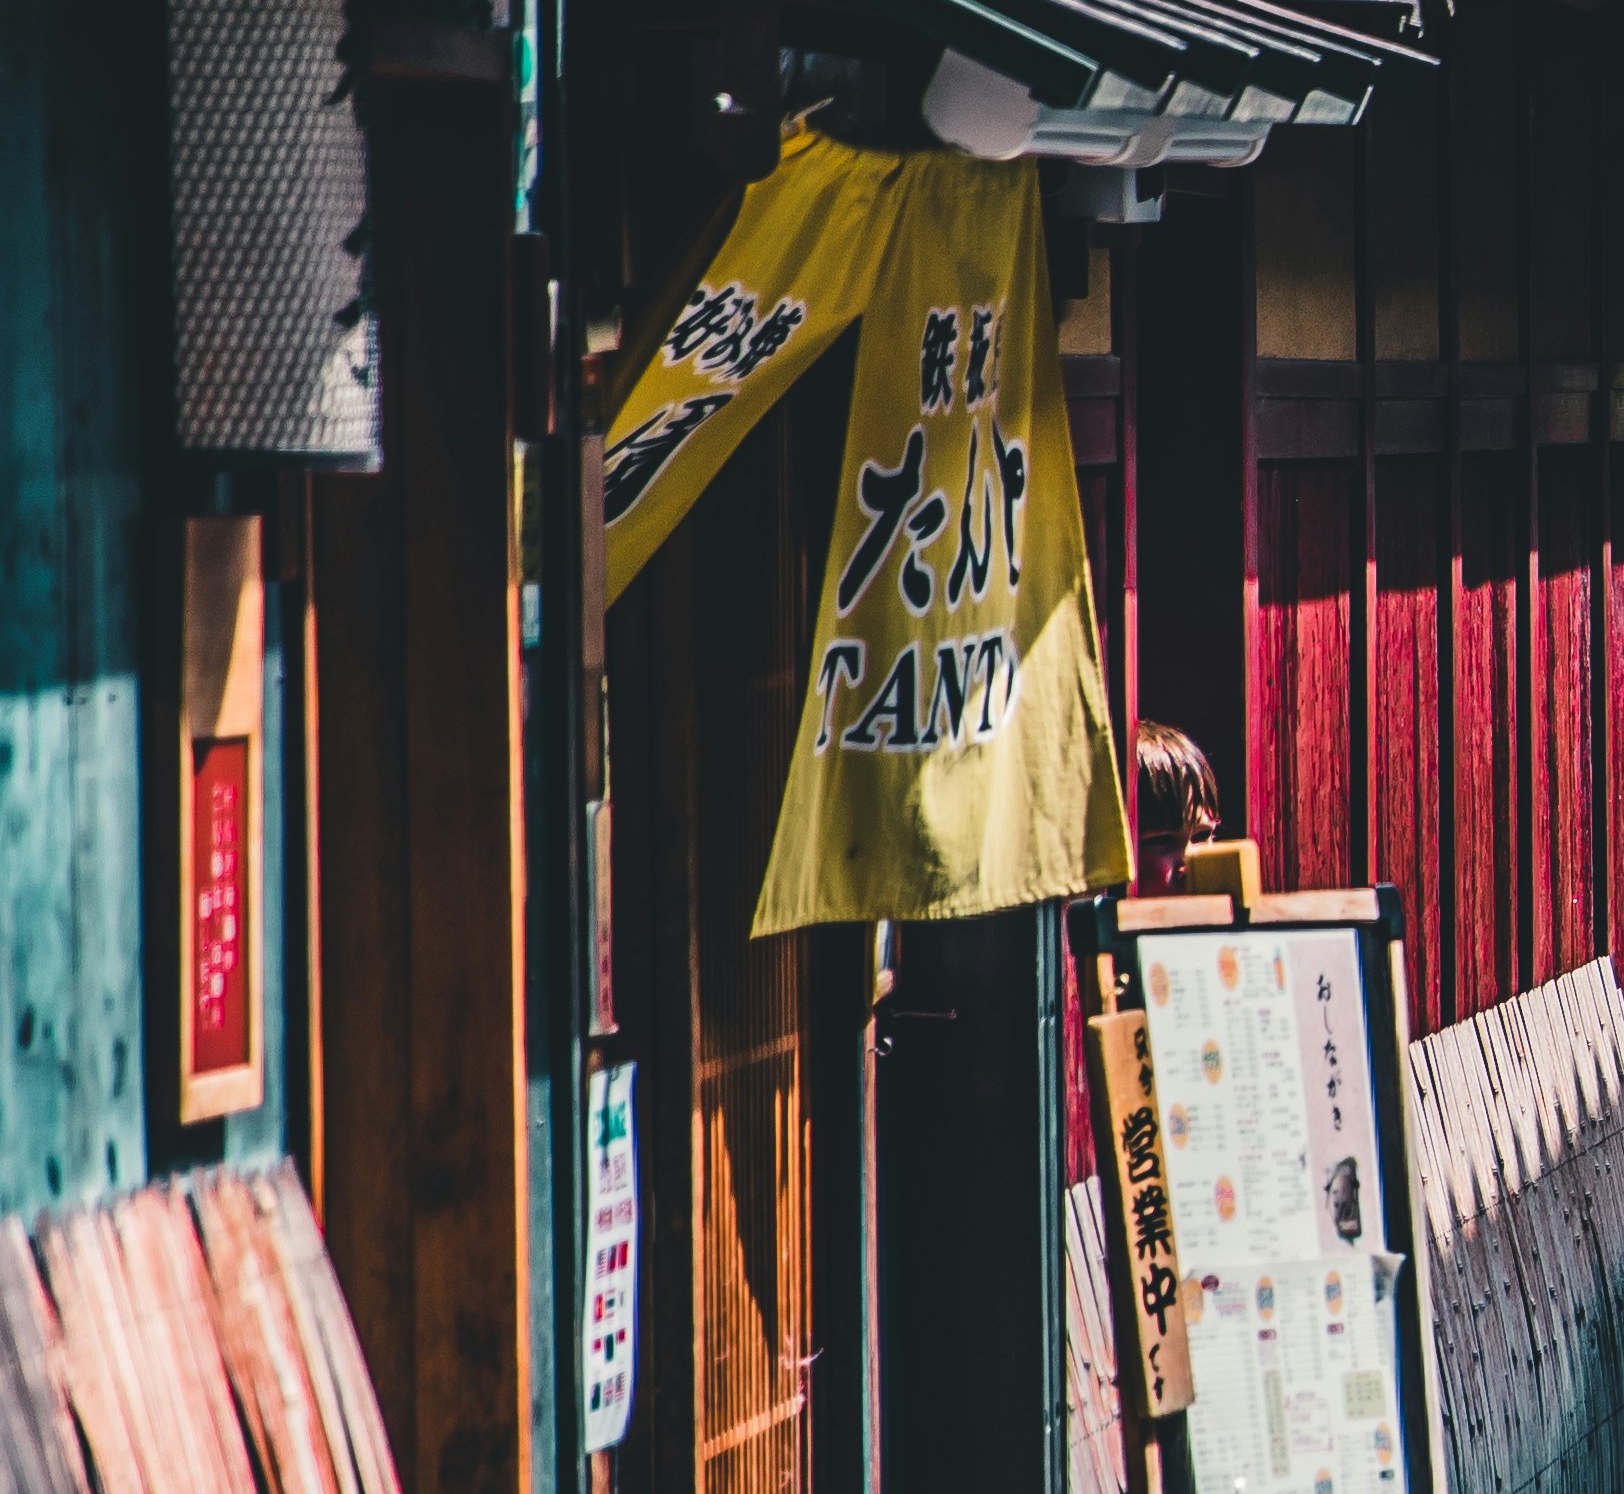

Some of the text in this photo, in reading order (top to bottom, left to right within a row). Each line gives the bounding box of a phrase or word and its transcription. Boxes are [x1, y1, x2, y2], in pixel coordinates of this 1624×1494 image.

[661, 284, 805, 381] 好み焼
[1316, 972, 1342, 1133] おしながき
[1121, 1105, 1177, 1337] 営業中
